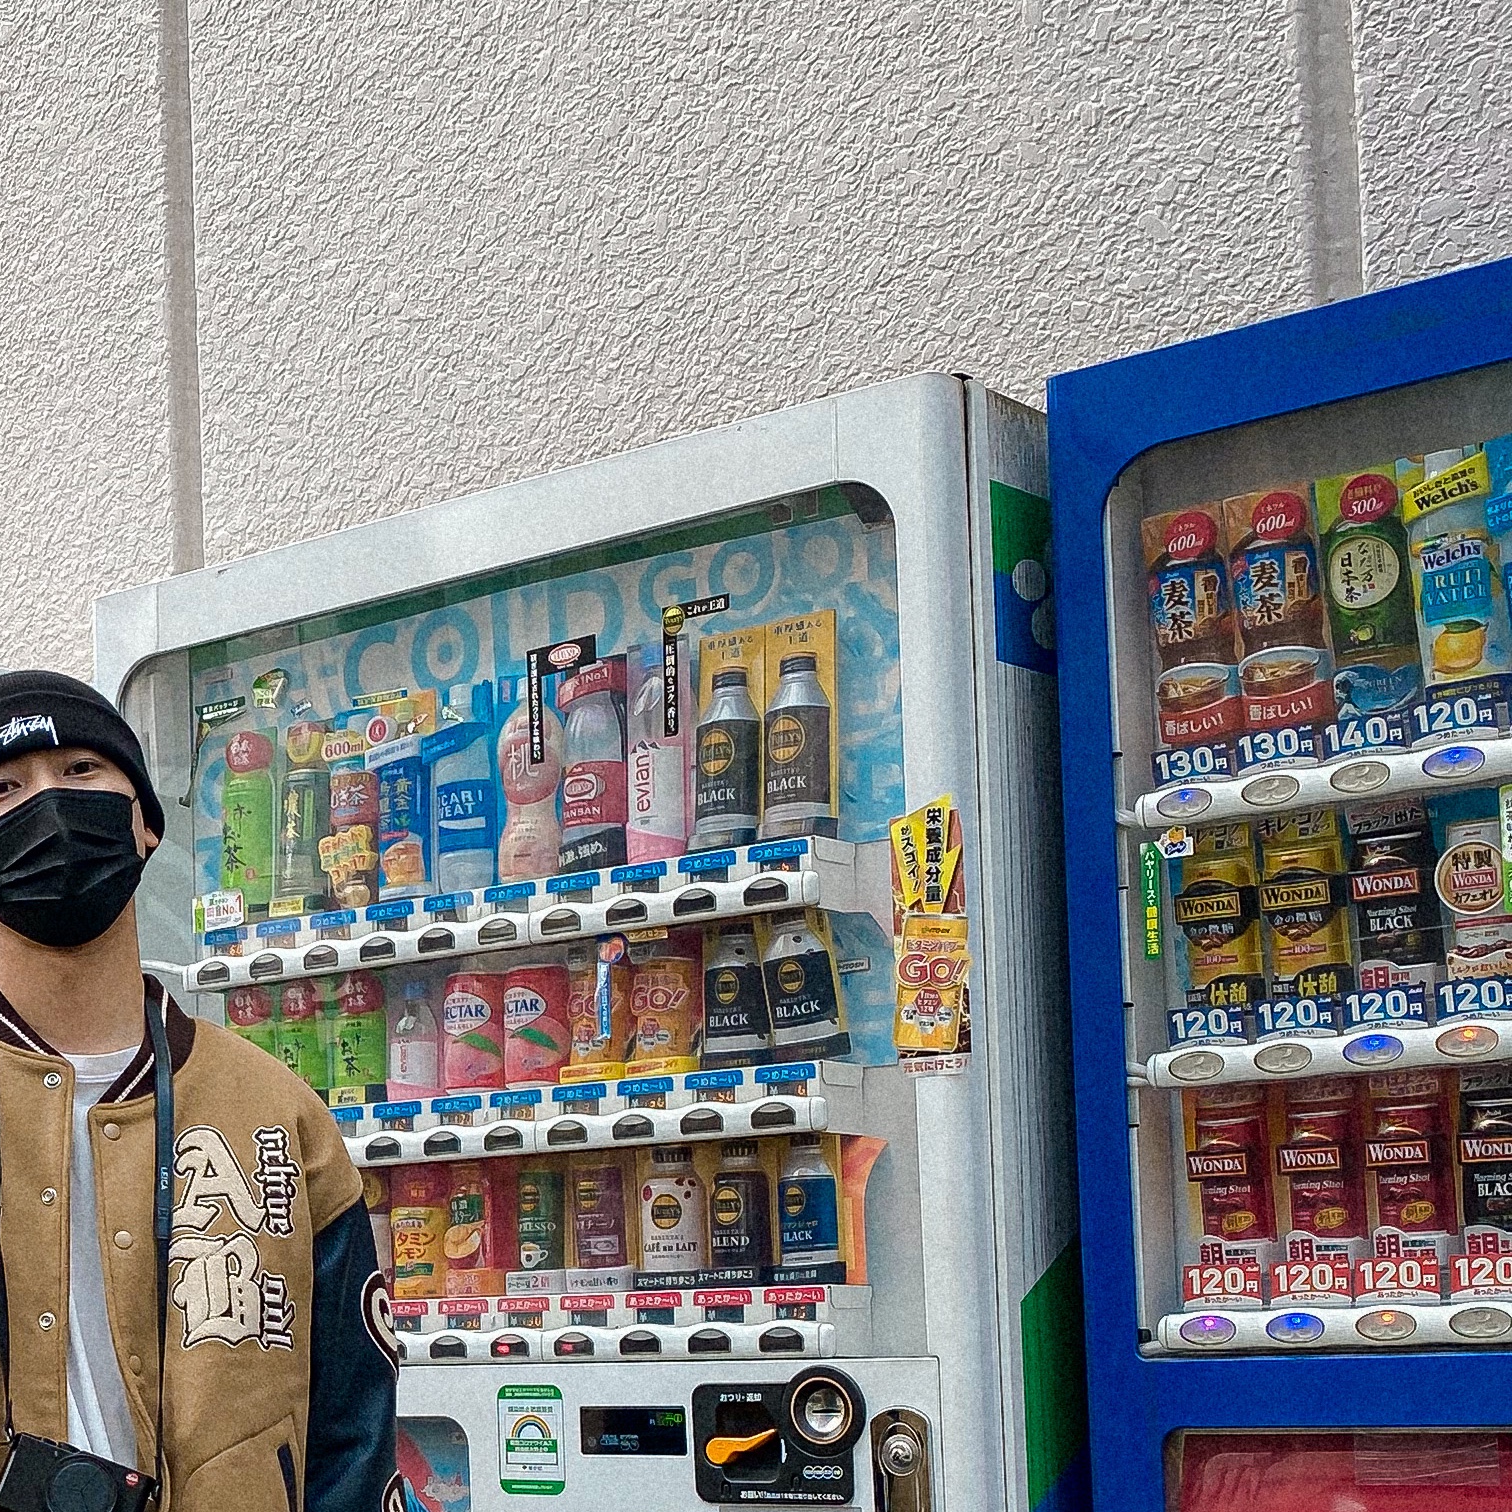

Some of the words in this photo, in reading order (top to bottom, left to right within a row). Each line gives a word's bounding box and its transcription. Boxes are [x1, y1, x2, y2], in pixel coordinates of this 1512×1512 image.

[1414, 479, 1478, 511] Welch's
[1422, 542, 1481, 570] Welch's
[1340, 552, 1362, 603] 日本茶
[1251, 560, 1284, 624] 麦茶
[1163, 580, 1193, 642] 麦茶
[1414, 697, 1493, 731] 120円
[1239, 729, 1314, 762] 130円
[1325, 717, 1403, 752] 140円
[325, 741, 364, 756] 600ml
[507, 743, 538, 780] 桃
[1156, 746, 1228, 780] 130円
[636, 752, 651, 813] evian
[697, 787, 736, 805] BLACK
[767, 776, 806, 794] BLACK
[926, 808, 943, 903] 栄養成分量
[1356, 873, 1414, 893] WONDA
[1453, 870, 1494, 888] WONDA
[1182, 899, 1235, 915] WONDA
[1267, 883, 1324, 904] WONDA
[1369, 914, 1413, 932] BLACK
[898, 953, 966, 988] GO!
[446, 1003, 484, 1019] ECTAR
[709, 1014, 748, 1027] BLACK
[775, 1000, 821, 1018] BLACK
[1258, 1000, 1332, 1031] 120円
[1346, 992, 1423, 1022] 120円
[1171, 1009, 1242, 1039] 120円
[1189, 1155, 1244, 1175] WONDA
[1281, 1149, 1336, 1169] WONDA
[1368, 1143, 1423, 1163] WONDA
[160, 1166, 169, 1191] LEICA
[396, 1232, 435, 1246] タミン
[676, 1242, 697, 1251] LAIT
[713, 1236, 750, 1246] BLEND
[1188, 1268, 1258, 1295] 120円
[1274, 1263, 1347, 1293] 120円
[1359, 1260, 1436, 1289] 120円
